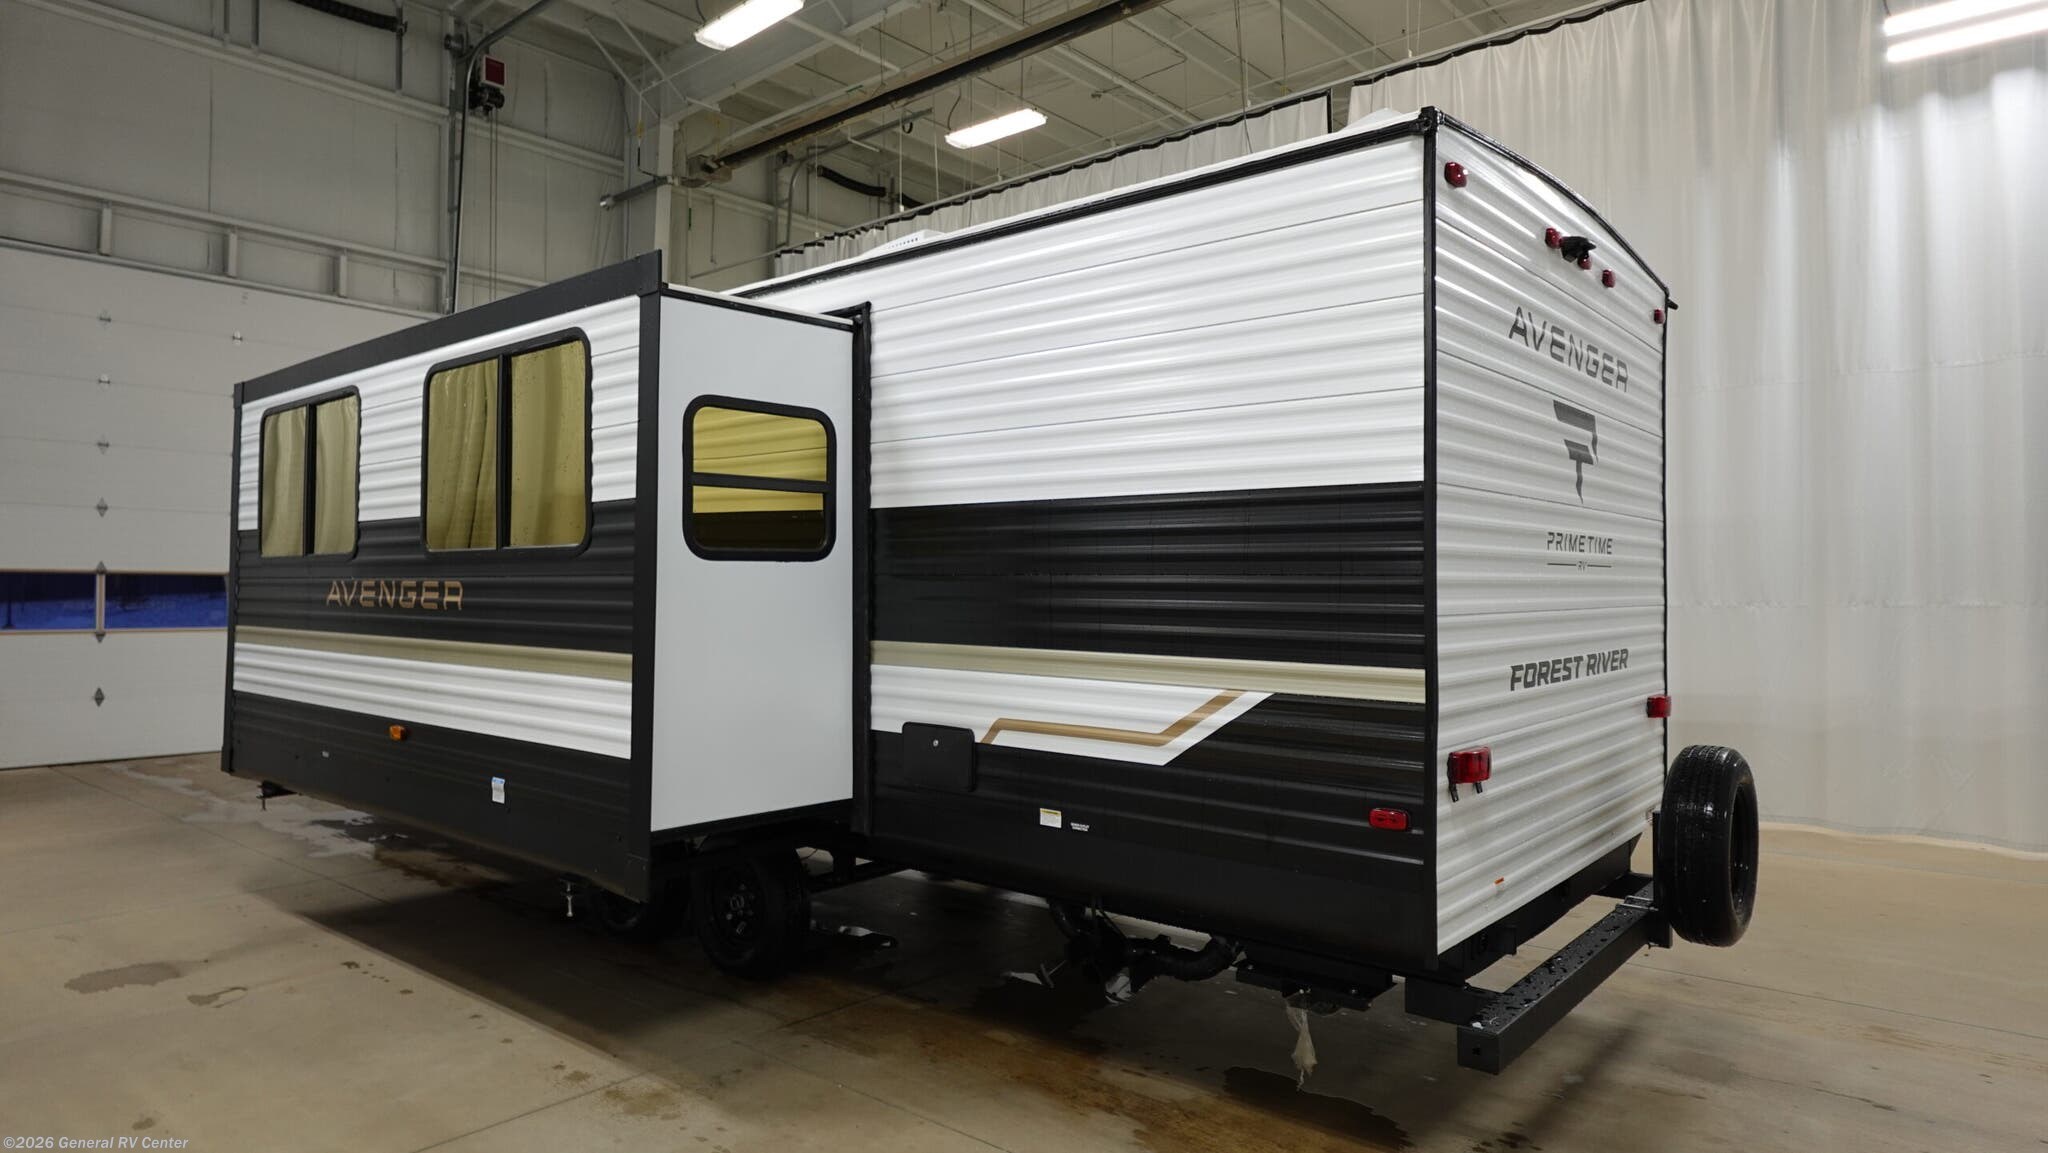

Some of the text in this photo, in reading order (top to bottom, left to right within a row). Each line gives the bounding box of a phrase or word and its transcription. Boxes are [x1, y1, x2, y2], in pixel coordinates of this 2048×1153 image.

[1508, 305, 1628, 393] AVENGER
[326, 579, 463, 611] AVENGER
[1510, 648, 1629, 692] FOREST RIVER
